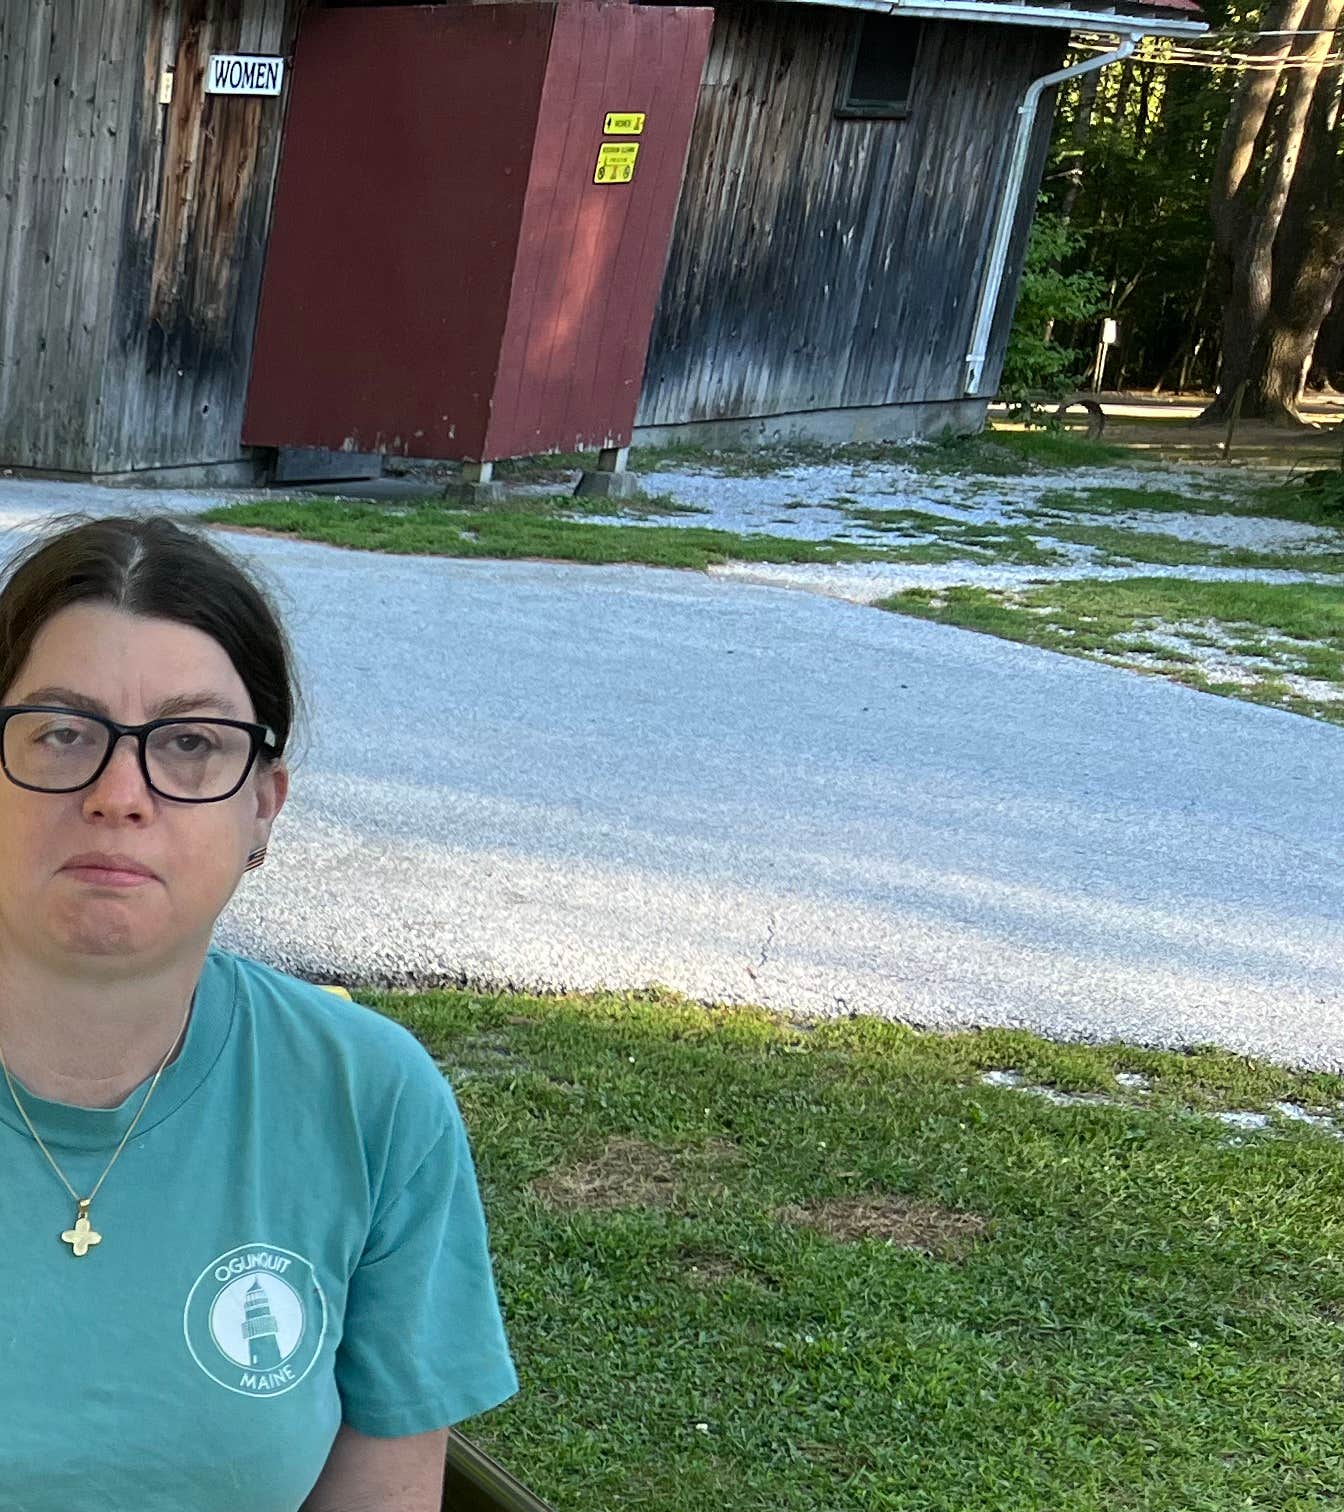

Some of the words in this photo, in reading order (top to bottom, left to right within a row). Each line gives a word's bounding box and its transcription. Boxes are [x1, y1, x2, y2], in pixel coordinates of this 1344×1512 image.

[214, 59, 279, 90] WOMEN
[214, 1251, 292, 1282] OGUNQUIT
[239, 1364, 296, 1391] MAINE
